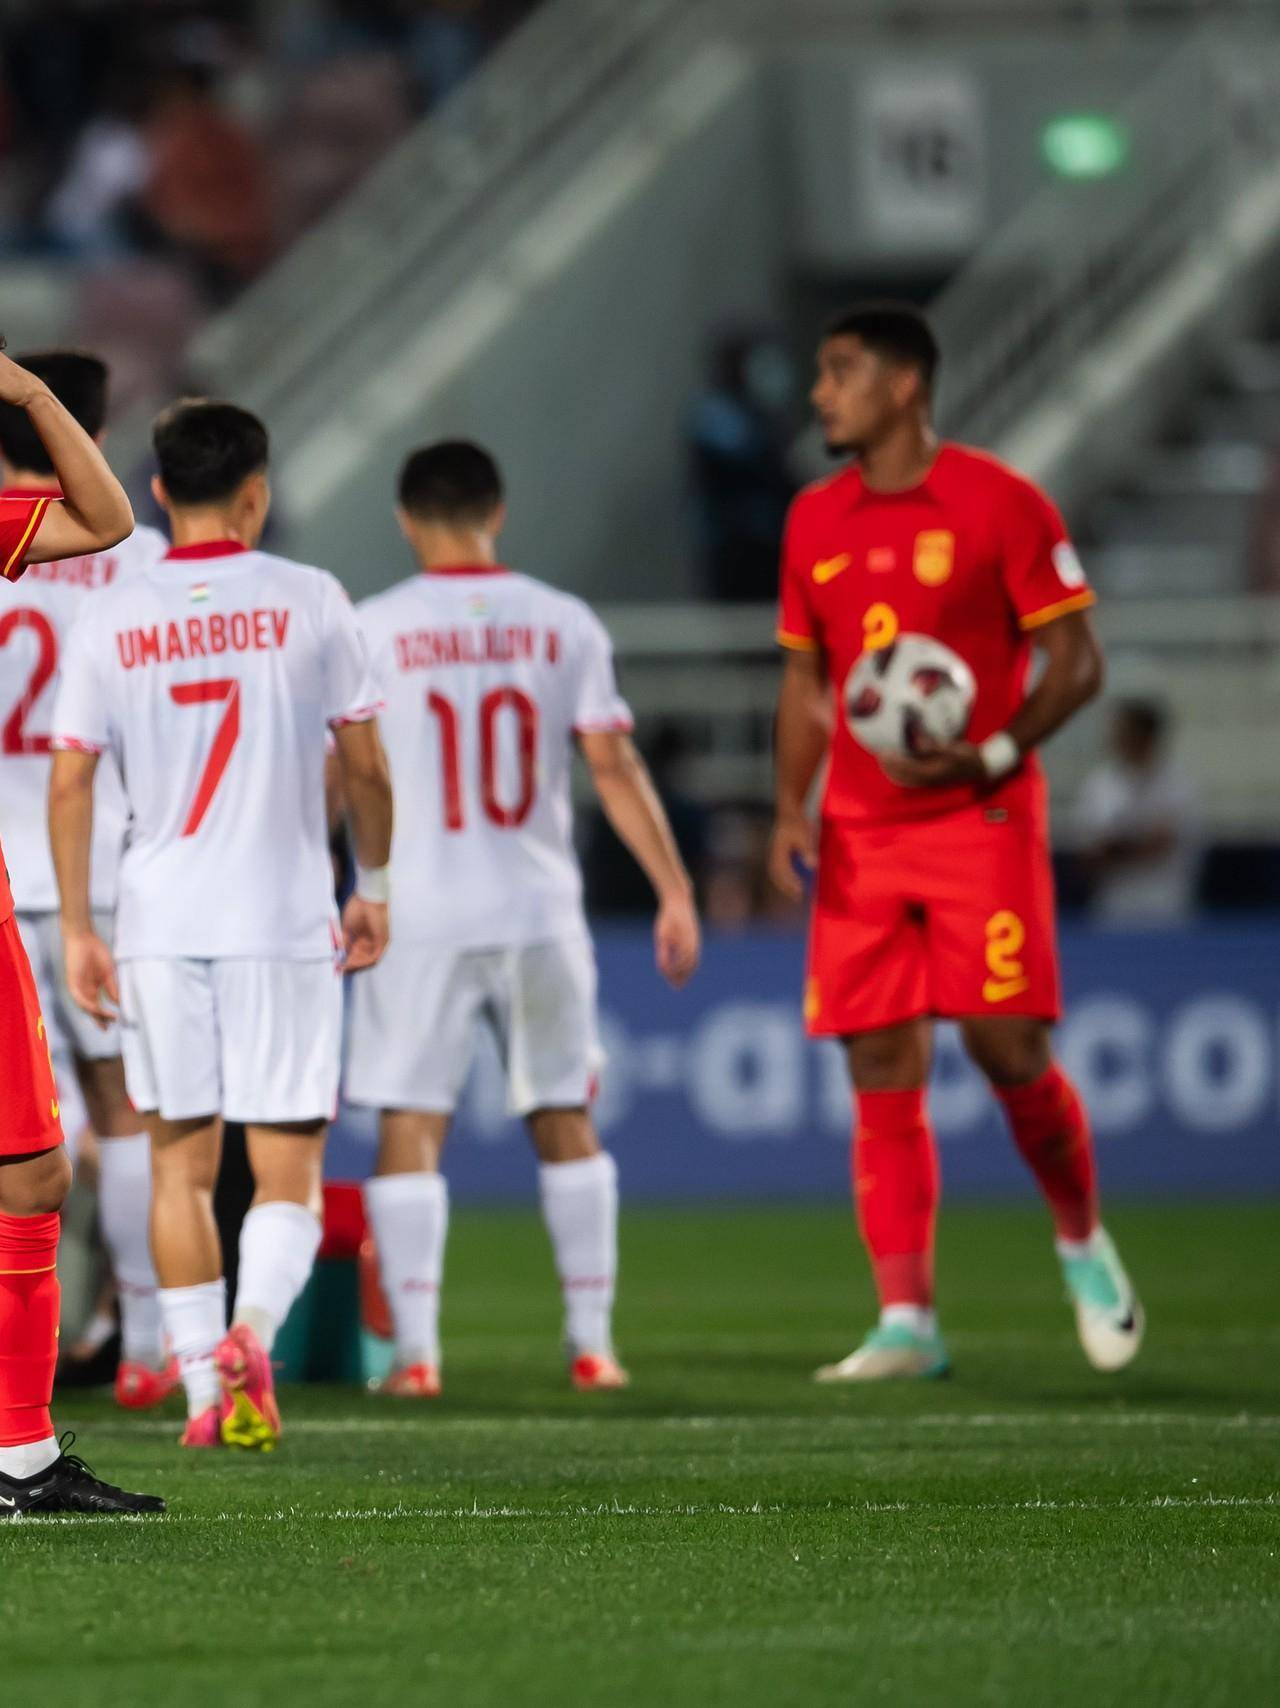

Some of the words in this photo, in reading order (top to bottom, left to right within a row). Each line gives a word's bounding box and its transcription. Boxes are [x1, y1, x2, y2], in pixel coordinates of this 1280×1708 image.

[117, 608, 290, 670] UMARBOEV
[168, 678, 241, 838] 7
[427, 685, 538, 833] 10
[984, 909, 1025, 978] 2
